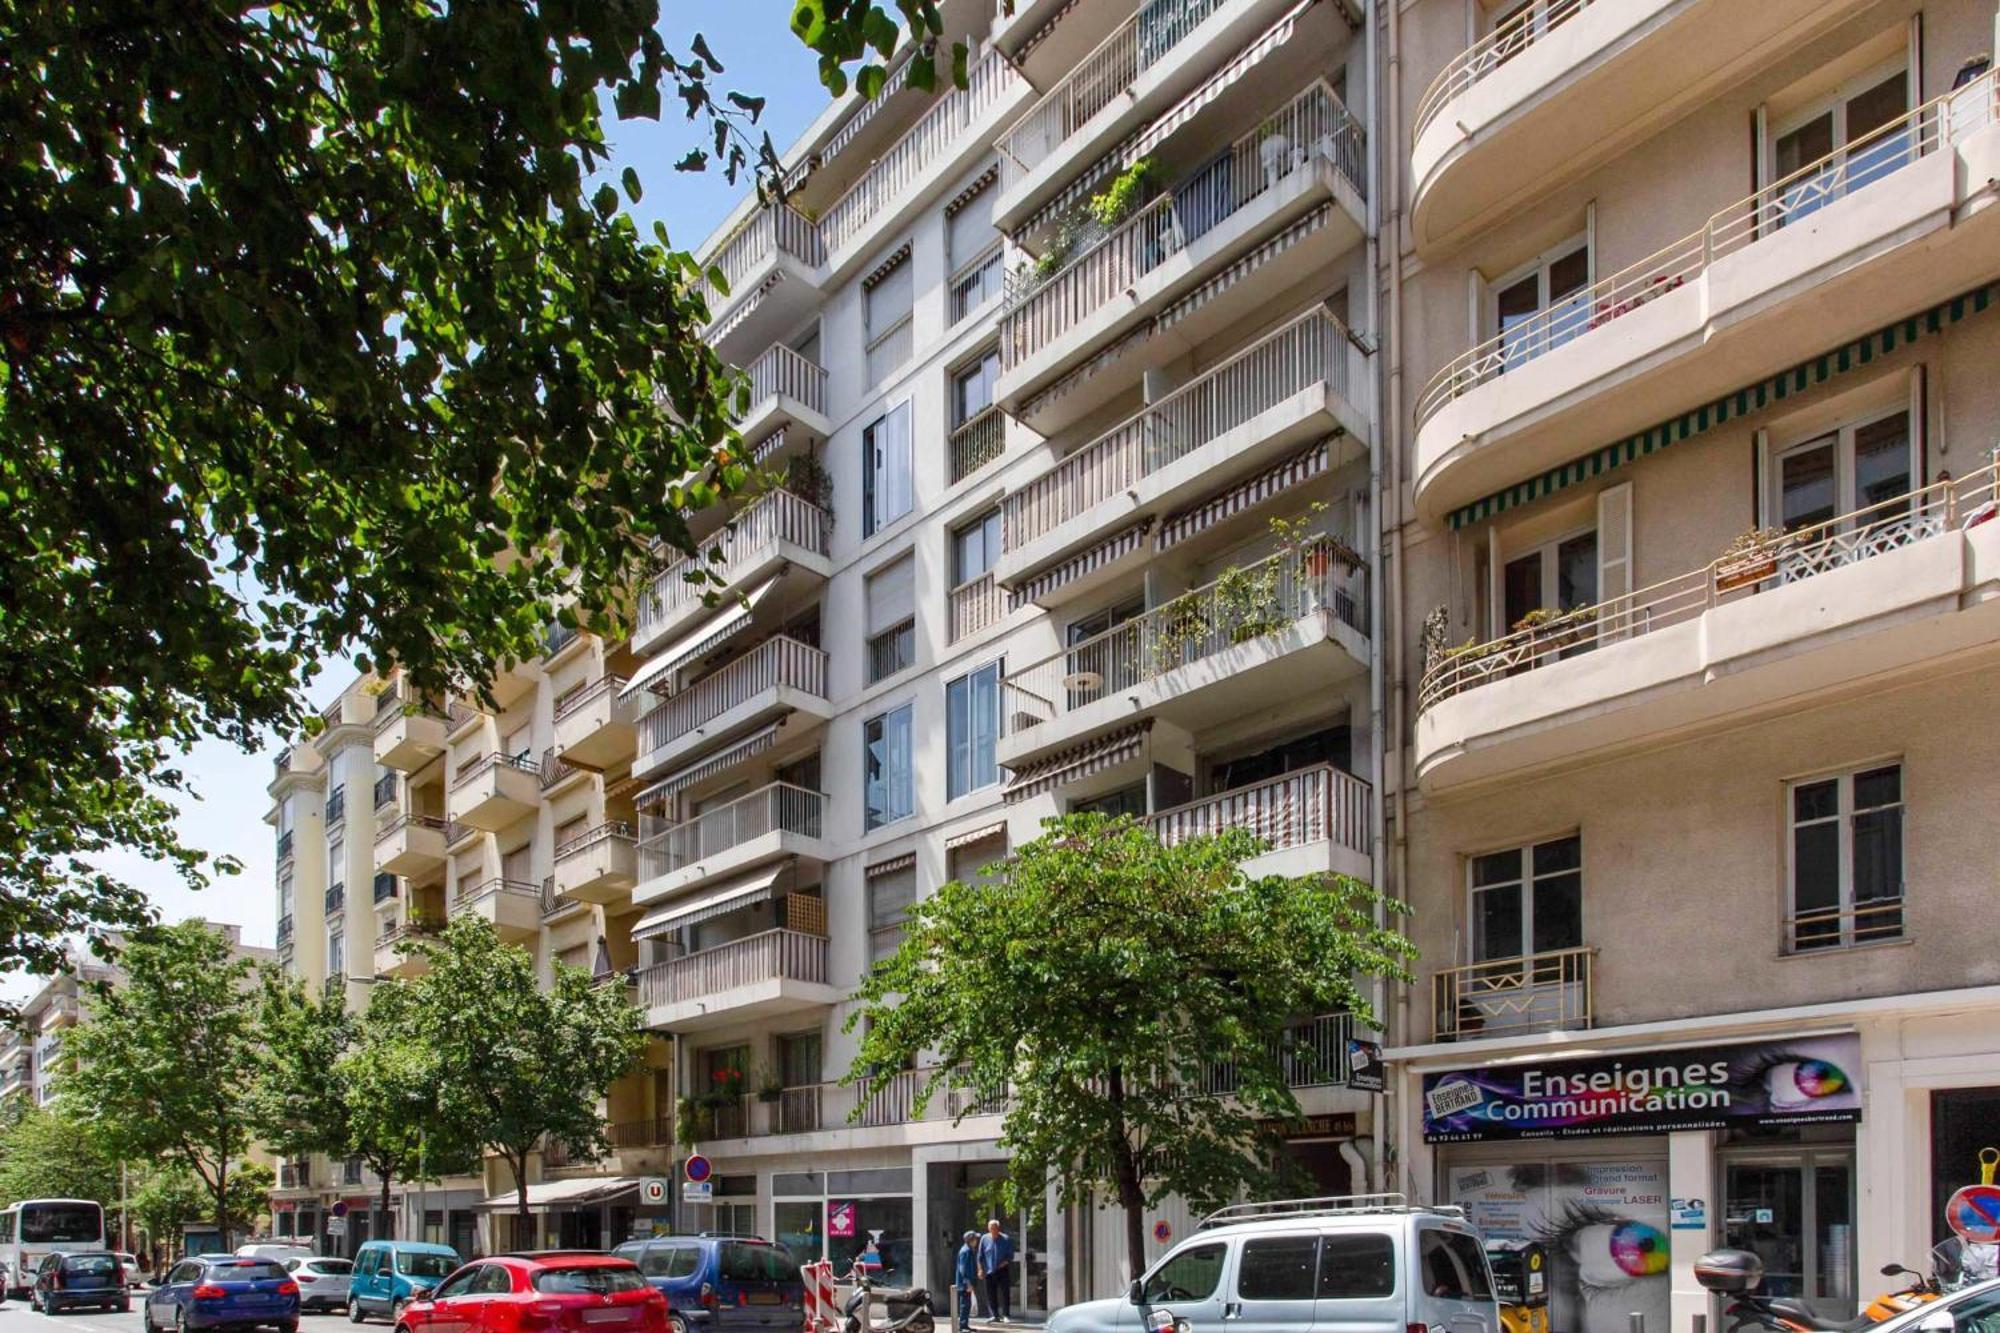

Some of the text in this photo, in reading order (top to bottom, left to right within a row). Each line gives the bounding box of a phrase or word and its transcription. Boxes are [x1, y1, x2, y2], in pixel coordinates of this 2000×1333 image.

[1523, 1061, 1729, 1097] Enseignes
[1432, 1084, 1475, 1105] Enseignes
[1434, 1091, 1478, 1115] BERTRAND
[1486, 1087, 1731, 1121] Communication
[1624, 1173, 1658, 1183] format
[650, 1186, 661, 1197] U
[1584, 1185, 1627, 1196] Gravure
[1623, 1195, 1662, 1205] LASER
